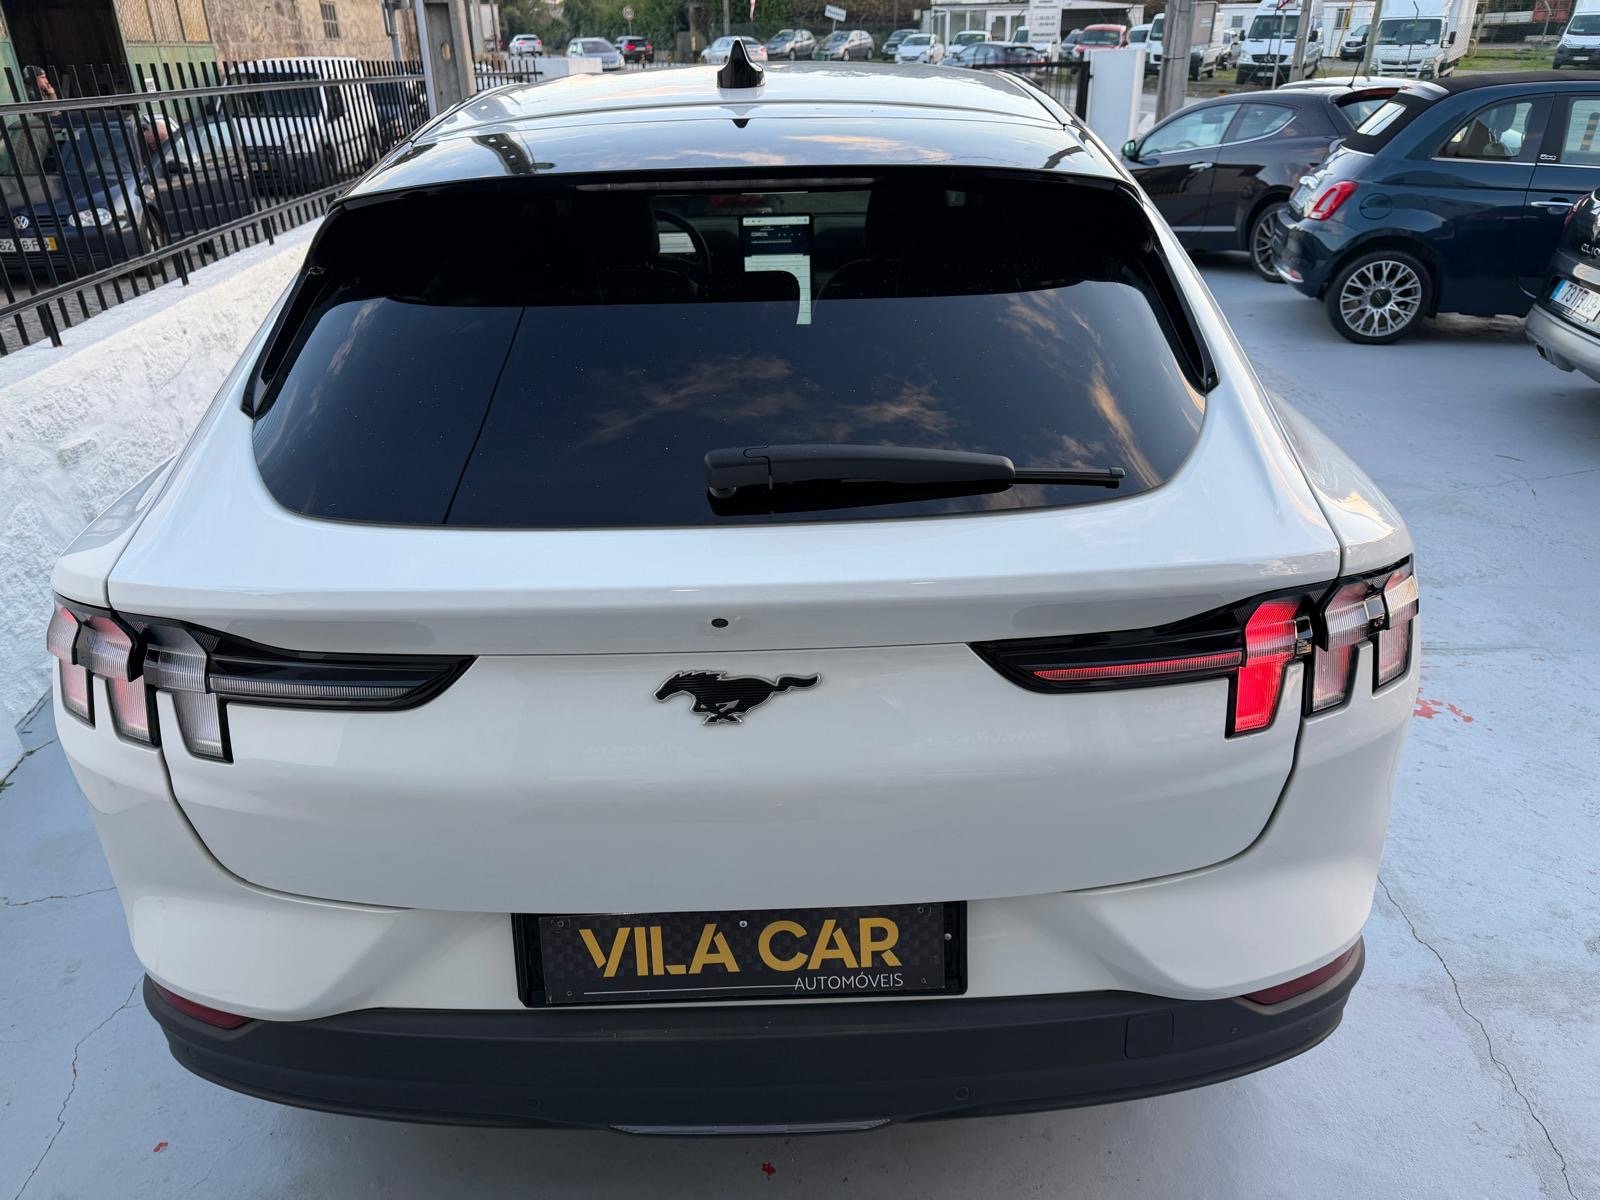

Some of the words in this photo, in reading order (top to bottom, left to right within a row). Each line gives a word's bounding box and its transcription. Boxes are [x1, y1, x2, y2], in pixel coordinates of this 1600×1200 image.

[579, 924, 740, 977] VILA
[758, 917, 902, 972] CAR
[795, 971, 904, 992] AUTOMÓVEIS
